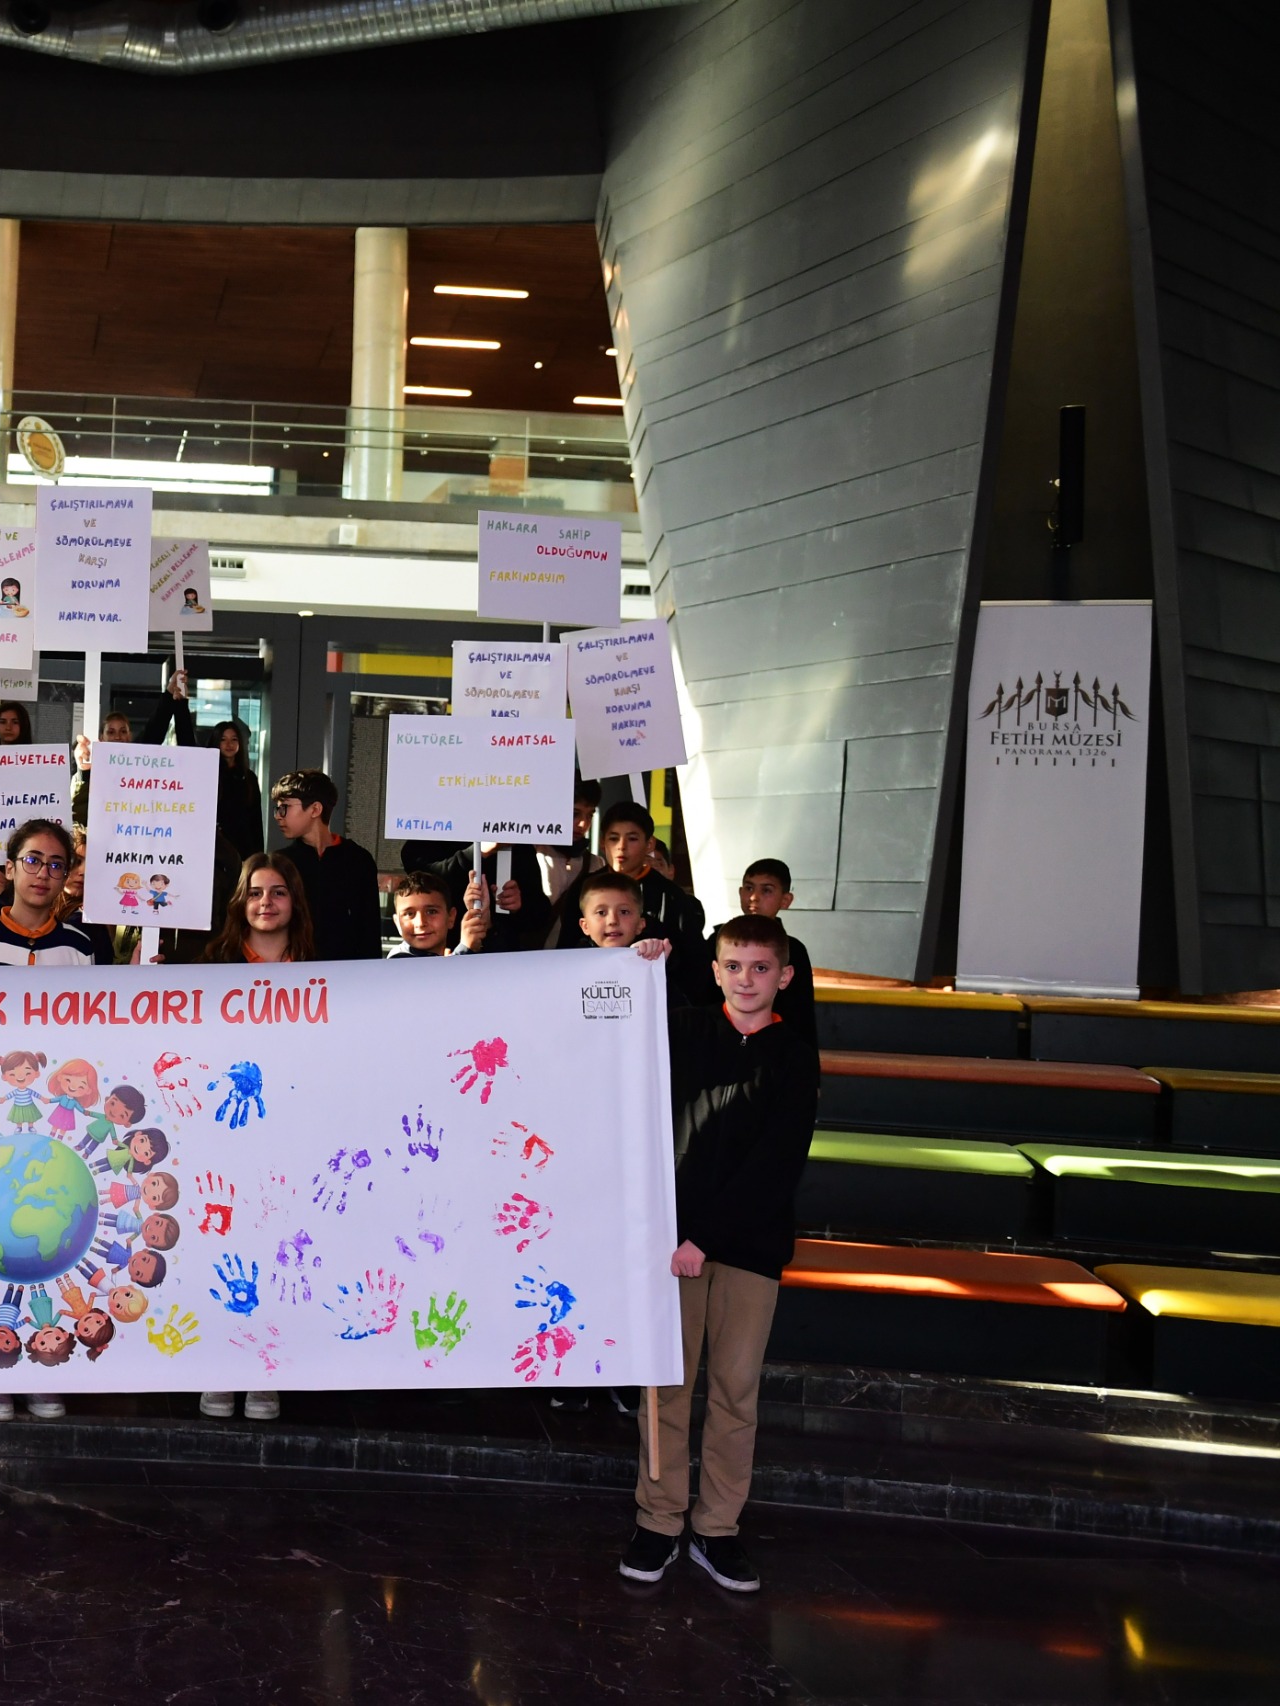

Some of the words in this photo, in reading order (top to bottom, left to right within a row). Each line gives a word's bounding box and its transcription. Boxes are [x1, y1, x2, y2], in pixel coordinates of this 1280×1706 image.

[50, 500, 134, 511] ÇALIŞTIRILMAYA
[84, 519, 96, 528] VE
[487, 520, 538, 533] HAKLARA
[5, 532, 18, 540] VE
[537, 546, 608, 560] OLDUĞUMUN
[78, 553, 107, 568] KARŞI
[490, 571, 565, 583] FARKINDAYIM
[71, 579, 120, 589] KORUNMA
[59, 612, 96, 621] HAKKIM
[577, 633, 654, 652] ÇALIŞTIRILMAYA
[468, 653, 551, 664] ÇALIŞTIRILMAYA
[616, 653, 628, 662] VE
[499, 671, 512, 679] VE
[614, 684, 640, 696] KARŞI
[605, 700, 652, 714] KORUNMA
[612, 720, 646, 731] HAKKIM
[1028, 722, 1081, 731] BURSA
[397, 733, 463, 746] KÜLTÜREL
[491, 735, 556, 747] SANATSAL
[990, 730, 1044, 746] FETİH
[1052, 729, 1122, 747] MÜZESİ
[1005, 748, 1071, 756] PANORAMA
[109, 754, 174, 768] KÜLTÜREL
[120, 777, 183, 790] SANATSAL
[438, 773, 530, 788] ETKİNLİKLERE
[105, 800, 195, 814] ETKİNLİKLERE
[116, 824, 172, 837] KATILMA
[397, 818, 452, 831] KATILMA
[482, 822, 532, 834] HAKKIM
[537, 824, 562, 834] VAR
[106, 852, 153, 864] HAKKIM
[159, 854, 184, 865] VAR
[582, 984, 631, 999] KÜLTÜR
[220, 978, 328, 1024] GÜNÜ
